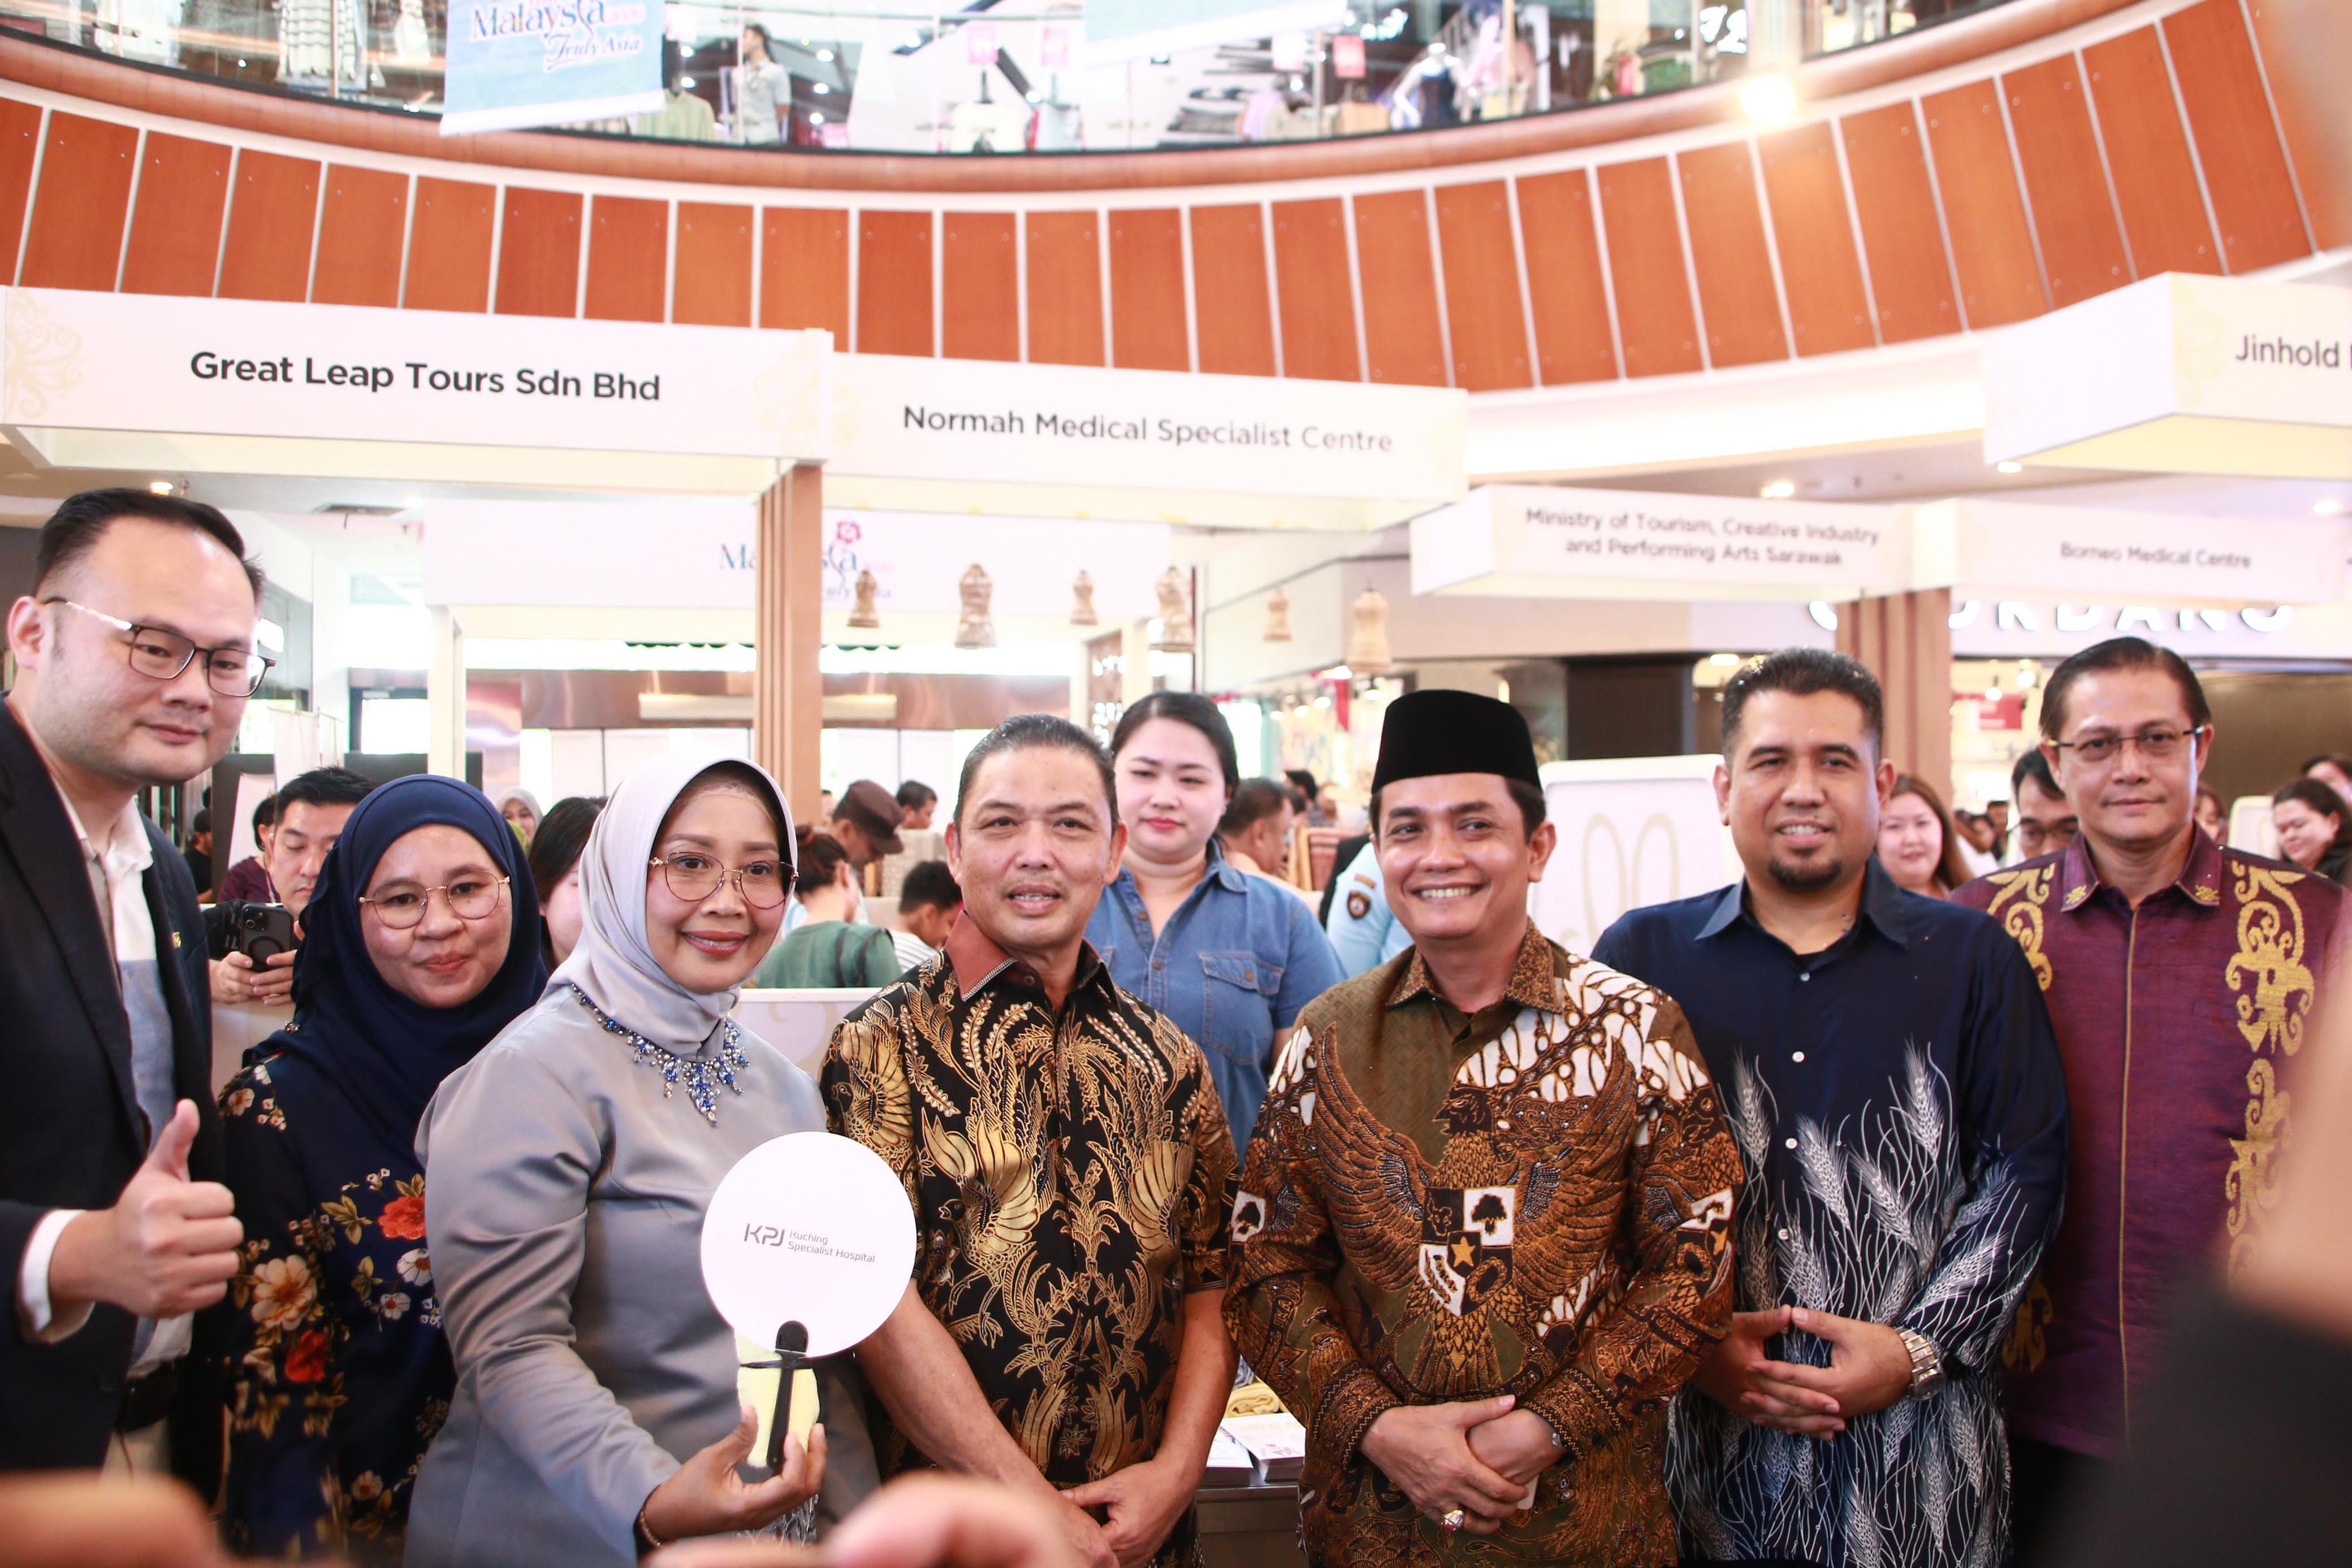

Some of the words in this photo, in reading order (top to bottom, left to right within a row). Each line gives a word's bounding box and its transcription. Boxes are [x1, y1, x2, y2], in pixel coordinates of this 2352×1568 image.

[2235, 334, 2340, 369] Jinhold
[190, 351, 293, 383] Great
[305, 357, 394, 393] Leap
[405, 362, 505, 394] Tours
[515, 368, 581, 397] Sdn
[593, 372, 660, 401] Bhd
[903, 404, 1024, 435] Normah
[1035, 412, 1147, 440] Medical
[1157, 418, 1291, 447] Specialist
[1301, 426, 1393, 453] Centre
[1526, 506, 1602, 531] Ministry
[1610, 512, 1629, 530] of
[1636, 513, 1717, 537] Tourism,
[1723, 517, 1800, 539] Creative
[1805, 523, 1879, 545] Industry
[1566, 537, 1602, 555] and
[1609, 538, 1716, 562] Performing
[1722, 544, 1759, 562] Arts
[1766, 547, 1843, 565] Sarawak
[2060, 541, 2122, 561] Borneo
[2128, 545, 2191, 565] Medical
[2195, 549, 2252, 569] Centre
[743, 1223, 785, 1247] KPJ
[789, 1230, 828, 1245] Kuching
[788, 1241, 833, 1257] Specialist
[835, 1249, 876, 1263] Hospital
